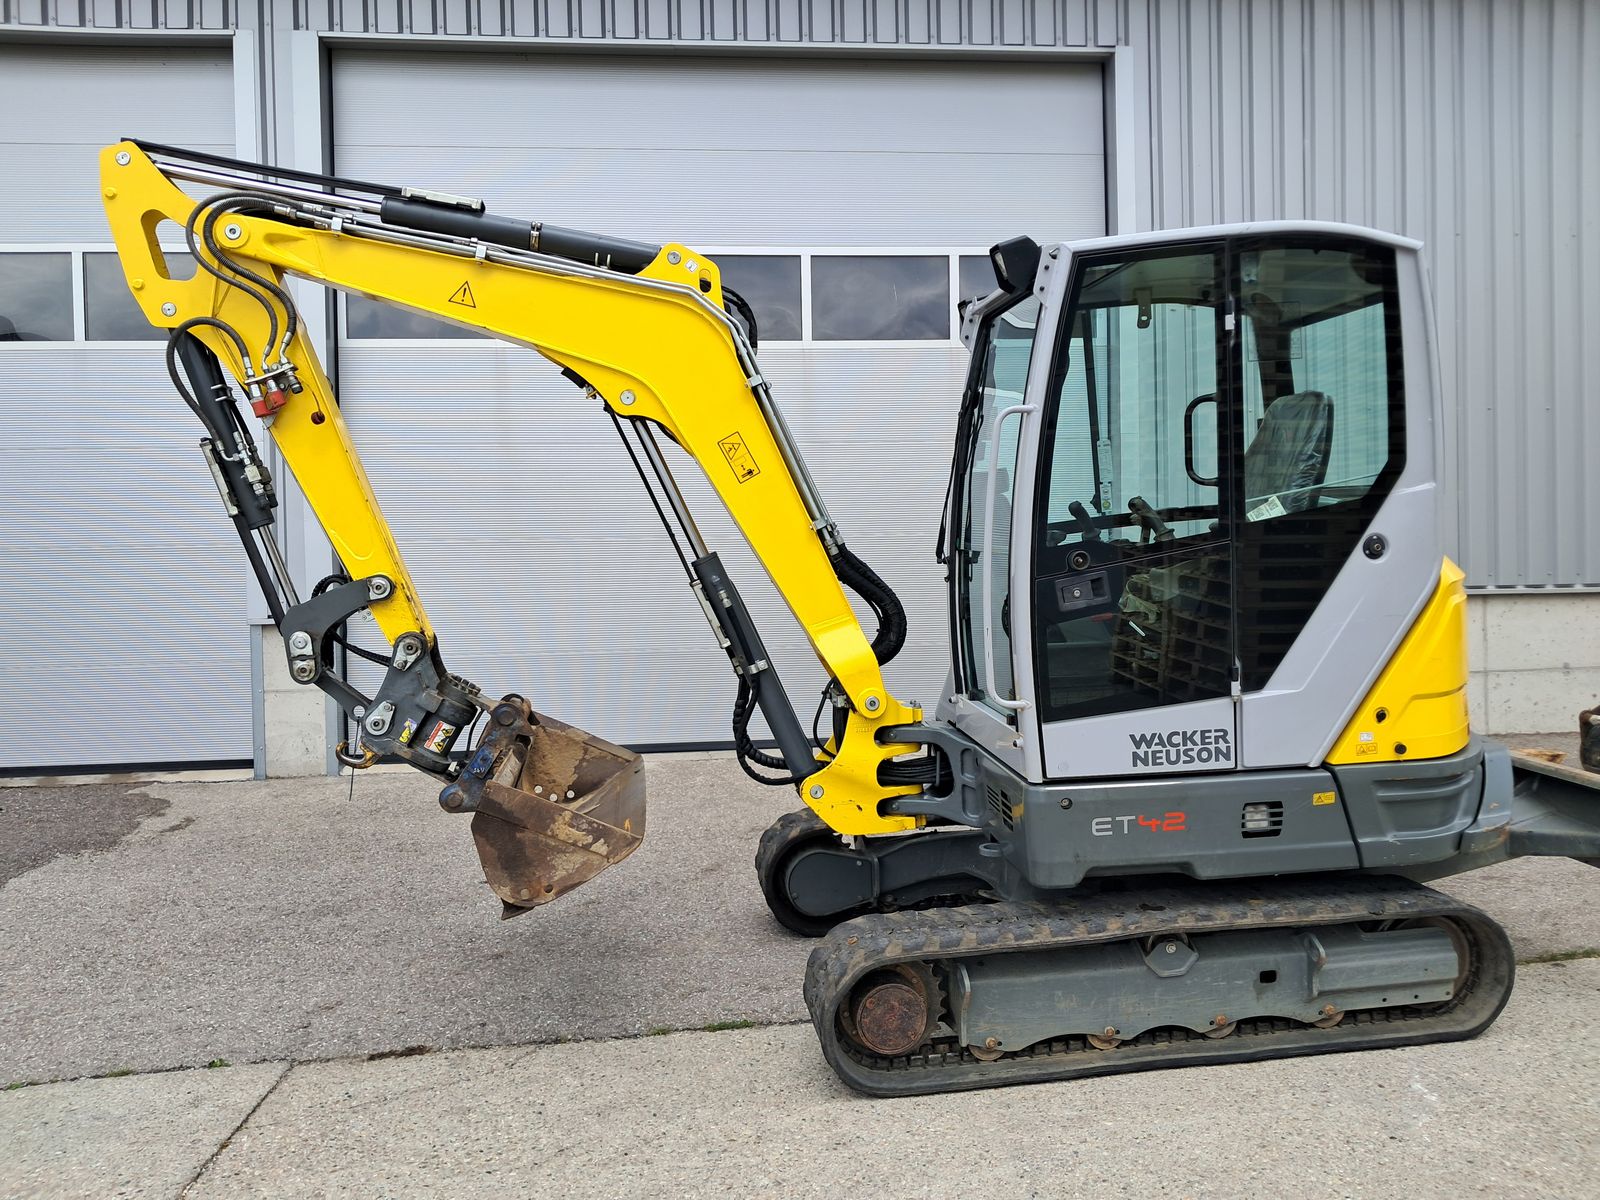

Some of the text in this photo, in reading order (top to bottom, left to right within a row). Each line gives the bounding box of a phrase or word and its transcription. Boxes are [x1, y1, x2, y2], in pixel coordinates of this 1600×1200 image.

[1129, 728, 1231, 750] WACKER
[1131, 745, 1232, 768] NEUSON
[1091, 811, 1186, 837] ET42
